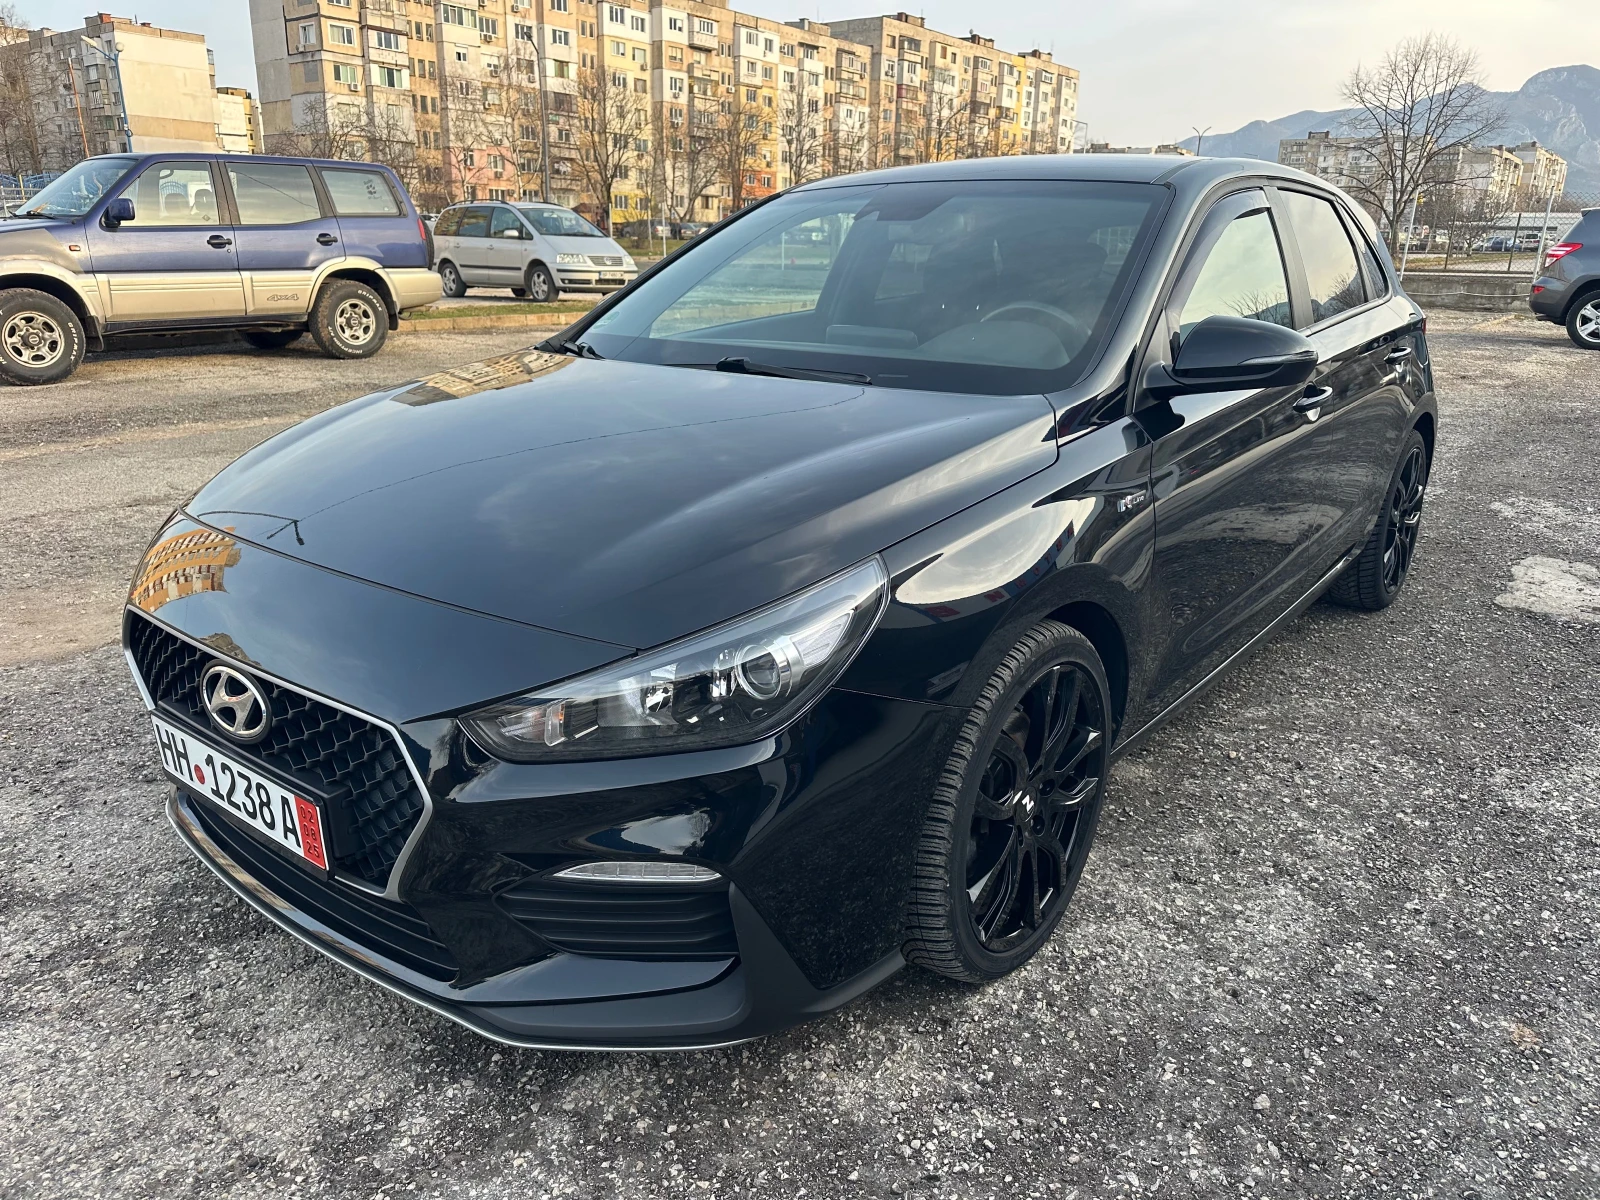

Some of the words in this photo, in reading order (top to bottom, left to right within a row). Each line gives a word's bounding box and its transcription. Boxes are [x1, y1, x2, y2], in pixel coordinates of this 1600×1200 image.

[267, 293, 299, 301] 4x4
[358, 290, 382, 311] GRIPMAX
[68, 322, 79, 361] GRIPMAX
[156, 724, 194, 782] HH
[300, 805, 315, 823] 02
[303, 825, 317, 840] 08
[306, 843, 320, 858] 25
